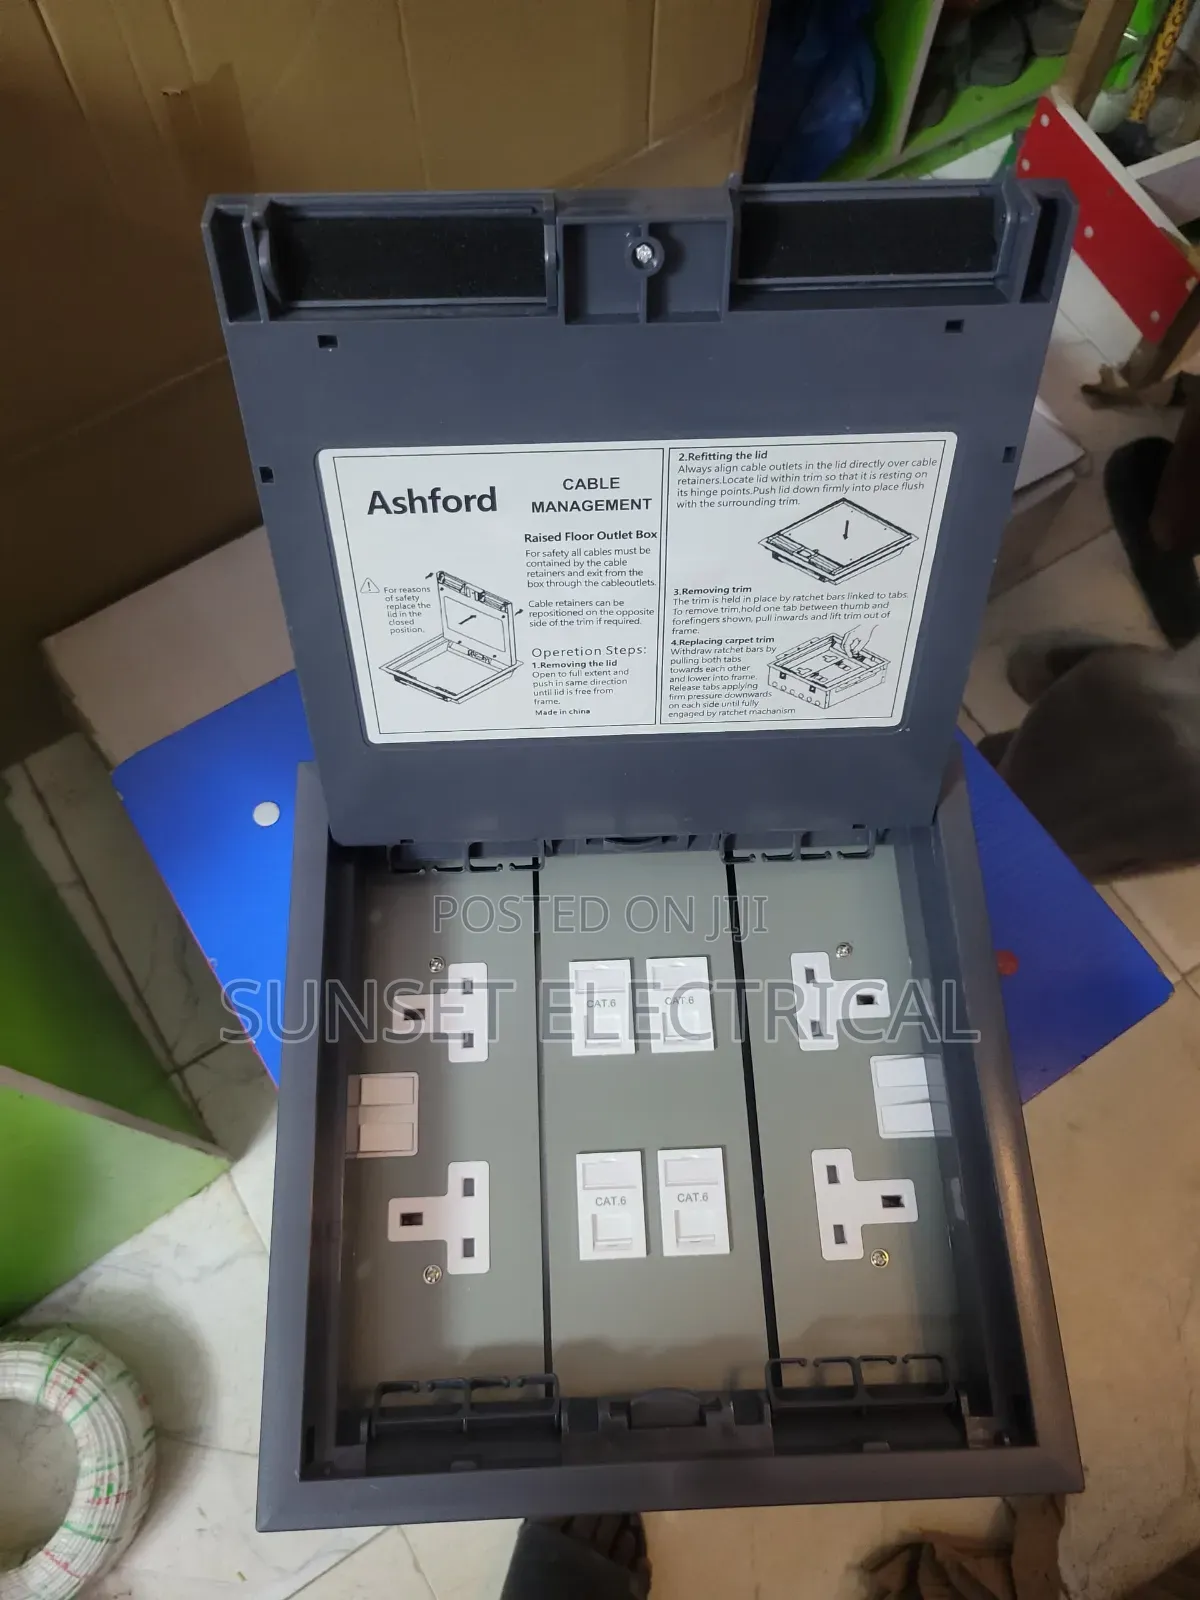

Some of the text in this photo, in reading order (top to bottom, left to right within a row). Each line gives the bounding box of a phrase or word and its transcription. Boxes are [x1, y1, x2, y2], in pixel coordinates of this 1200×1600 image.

[678, 450, 768, 462] 2.Refitting the lid
[677, 457, 938, 475] Always align cable outlets the lid directly over cable
[756, 474, 769, 484] lid
[770, 473, 801, 483] within
[803, 472, 823, 482] trim
[838, 472, 859, 481] that
[879, 470, 913, 481] resting
[563, 477, 620, 491] CABLE
[677, 488, 689, 497] its
[690, 488, 719, 499] hinge
[778, 485, 790, 496] lid
[790, 485, 820, 496] down
[822, 484, 851, 495] firmly
[852, 483, 872, 492] into
[873, 482, 900, 494] place
[901, 481, 925, 491] flush
[367, 486, 498, 516] Ashford
[532, 498, 653, 514] MANAGEMENT
[676, 496, 801, 509] with the surrounding trim.
[524, 530, 658, 543] Raised Floor Outlet Box
[525, 547, 638, 559] For safety all cables must
[526, 557, 628, 568] contained the cable
[527, 568, 644, 578] retainers and exit from the
[527, 580, 545, 588] box
[546, 579, 583, 590] through
[584, 579, 600, 587] the
[673, 585, 752, 596] 3.Removing trim
[395, 594, 420, 602] safety
[673, 597, 690, 606] The
[691, 596, 710, 606] trim
[721, 595, 742, 604] held
[753, 595, 778, 605] place
[792, 594, 825, 602] ratchet
[826, 593, 846, 601] bars
[847, 592, 875, 600] linked
[386, 602, 416, 612] replace
[528, 600, 554, 608] Cable
[555, 599, 594, 607] retainers
[685, 607, 719, 615] remove
[782, 604, 798, 612] tab
[799, 604, 838, 612] between
[840, 602, 871, 611] thumb
[872, 601, 890, 610] and
[408, 610, 422, 618] the
[529, 608, 655, 620] repositioned the opposite
[672, 616, 721, 626] forefingers
[755, 614, 773, 624] pull
[774, 613, 809, 622] inwards
[810, 612, 829, 621] and
[843, 612, 862, 620] trim
[388, 618, 415, 626] closed
[529, 619, 548, 628] side
[559, 618, 575, 627] the
[670, 636, 775, 647] 4.Replacing carpet trim
[606, 645, 647, 657] Steps:
[670, 646, 764, 656] Withdraw ratchet bars
[588, 660, 604, 668] the
[606, 659, 618, 667] lid
[670, 656, 742, 666] pulling both tabs
[670, 664, 751, 674] towards other
[532, 671, 556, 680] Open
[669, 675, 686, 683] and
[687, 675, 712, 683] lower
[533, 680, 554, 689] push
[590, 677, 628, 687] direction
[669, 682, 759, 692] Release tabs applying
[533, 689, 553, 697] until
[554, 688, 565, 696] lid
[593, 687, 614, 695] from
[669, 691, 773, 701] firm downwards
[702, 700, 760, 709] side fully
[668, 710, 705, 719] engaged
[718, 709, 748, 717] ratchet
[586, 999, 616, 1008] CAT.6
[664, 996, 694, 1005] CAT.6
[595, 1196, 627, 1206] CAT.6
[677, 1192, 709, 1203] CAT.6
